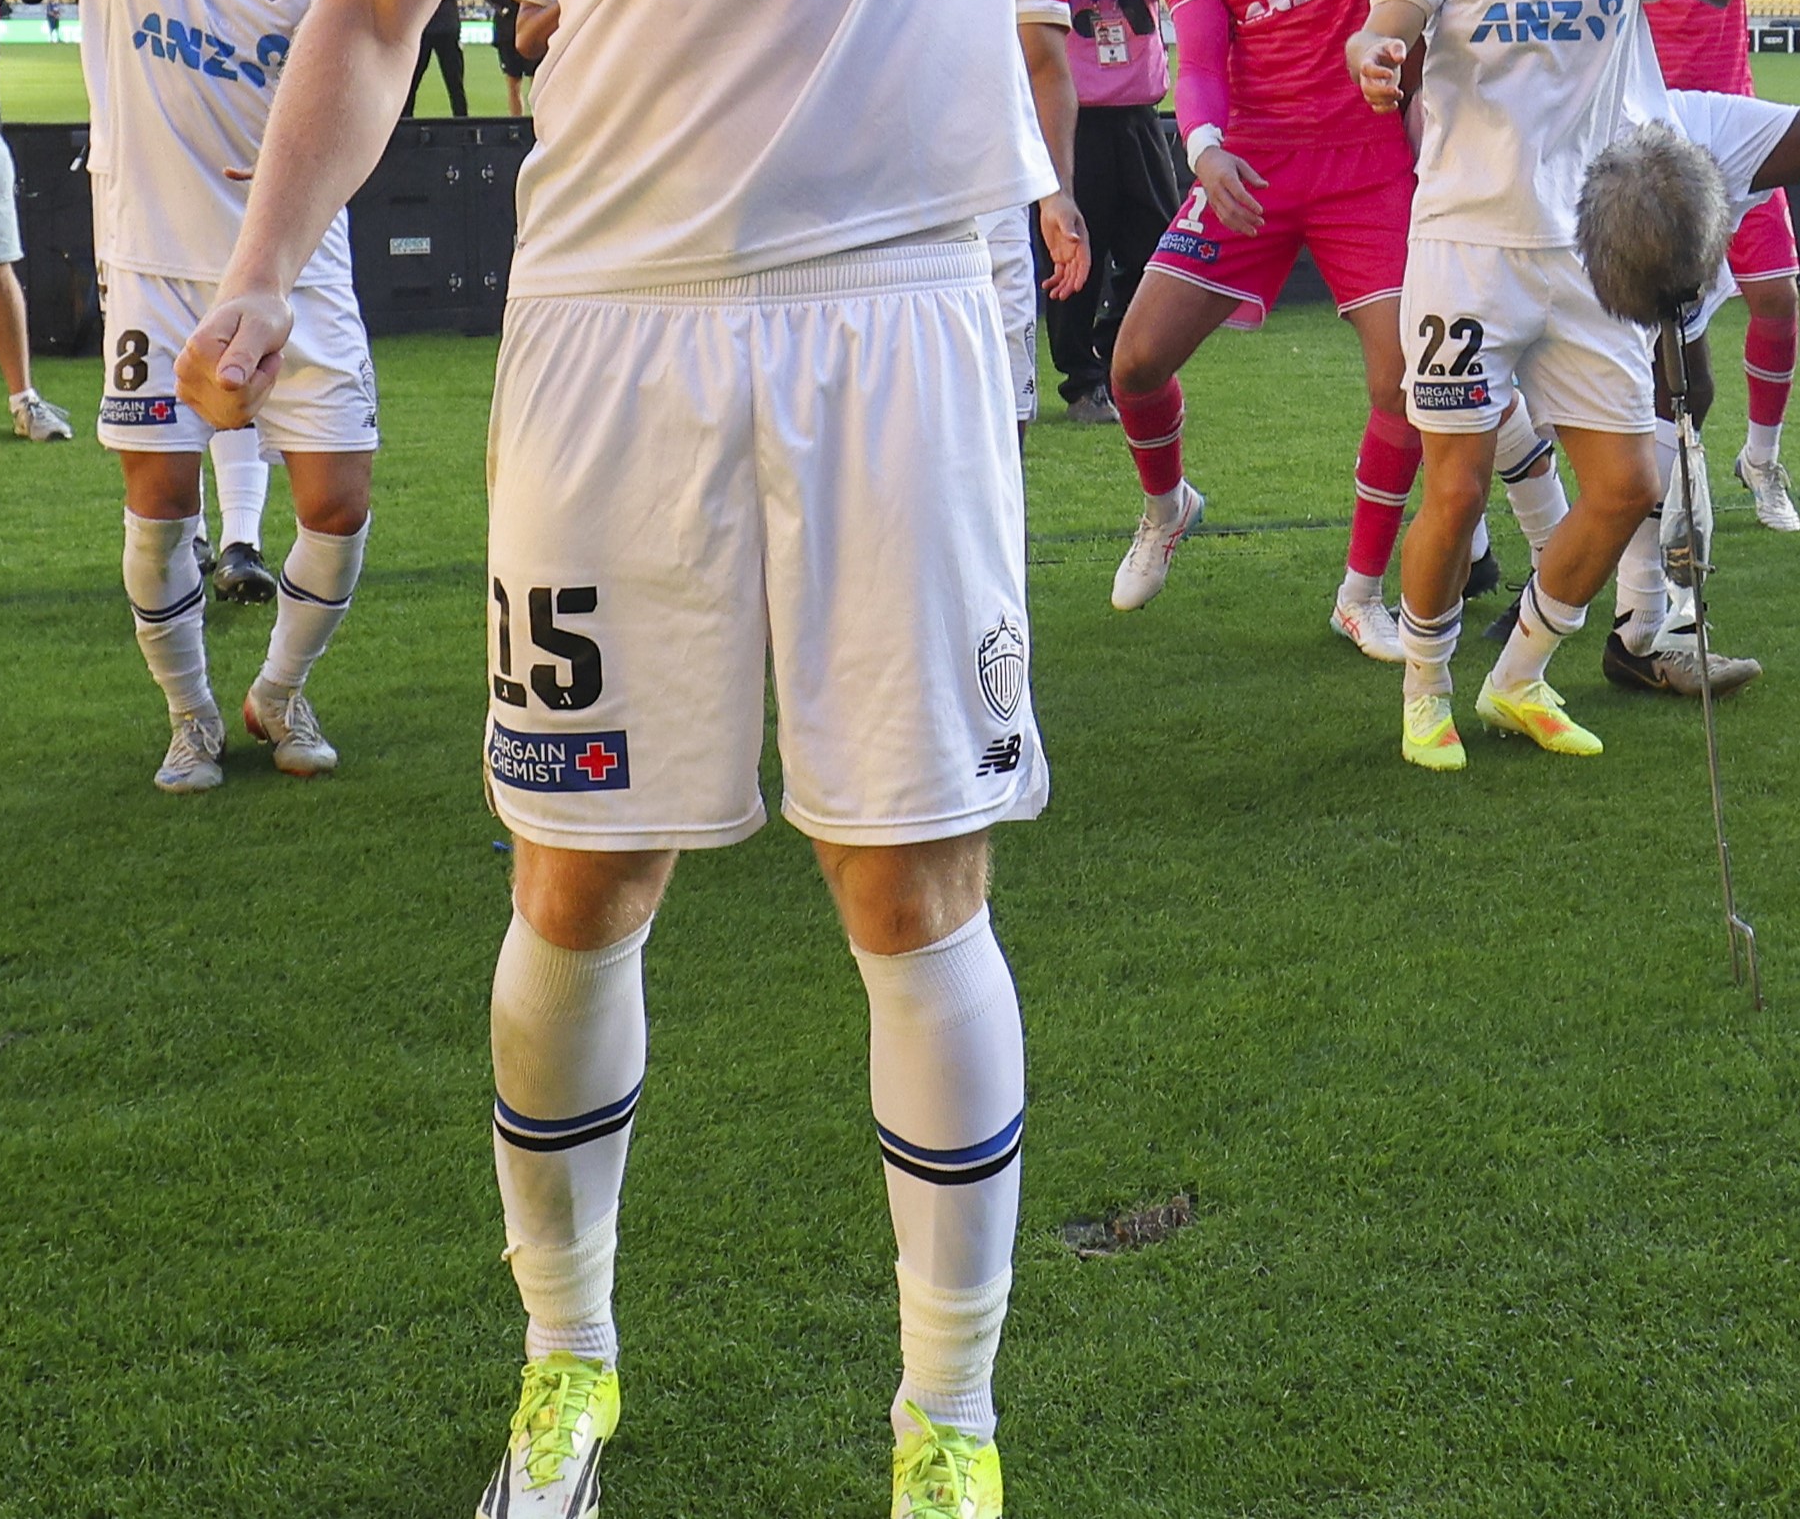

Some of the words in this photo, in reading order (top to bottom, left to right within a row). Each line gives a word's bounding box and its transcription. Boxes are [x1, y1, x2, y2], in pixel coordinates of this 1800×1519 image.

[1470, 0, 1583, 43] ANZ
[133, 12, 239, 82] ANZ
[1176, 186, 1208, 234] 1
[114, 329, 149, 392] 8
[1417, 314, 1484, 377] 22
[1415, 385, 1465, 397] BARGAIN
[1417, 396, 1465, 407] CHEMIST
[494, 576, 603, 711] 15
[490, 748, 566, 783] CHEMIST
[494, 728, 566, 763] BARGAIN
